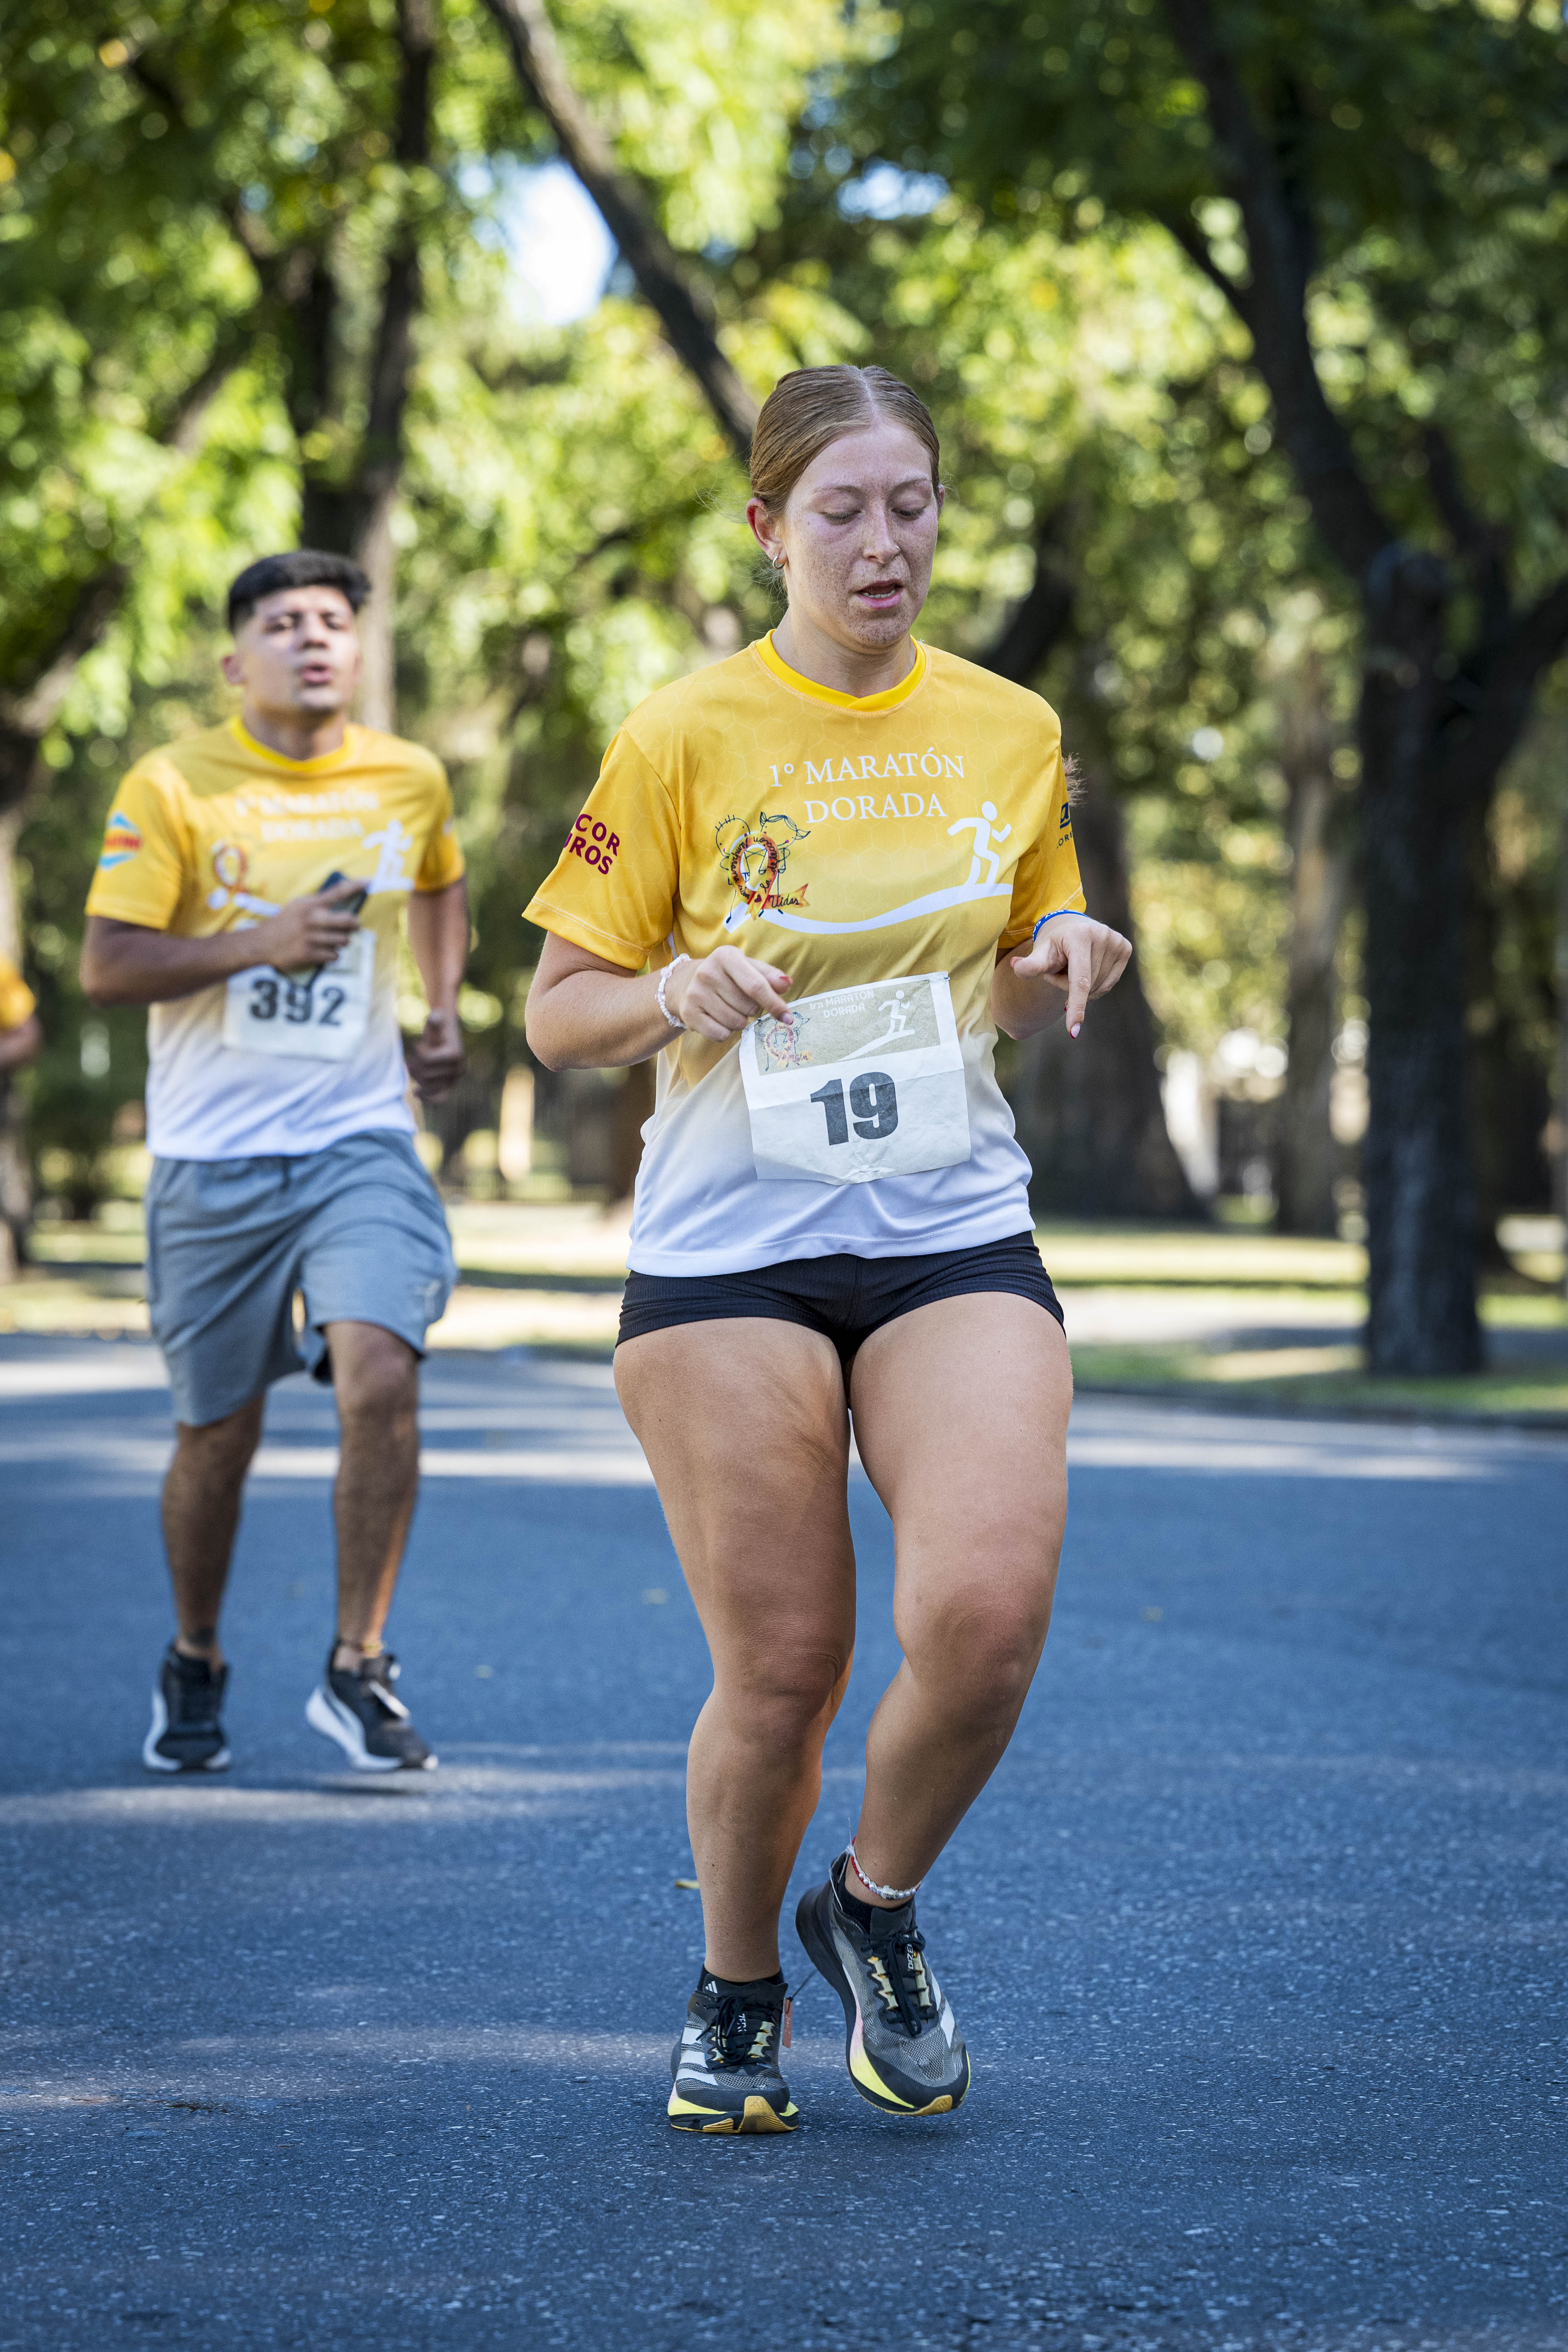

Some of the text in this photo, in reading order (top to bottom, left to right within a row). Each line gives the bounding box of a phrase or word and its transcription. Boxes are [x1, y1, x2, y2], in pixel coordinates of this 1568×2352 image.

[804, 746, 965, 784] MARATÓN
[803, 793, 947, 823] DORADA
[575, 814, 620, 856] COR
[250, 979, 347, 1025] 392
[823, 1003, 866, 1018] DORADA
[810, 1071, 899, 1146] 19
